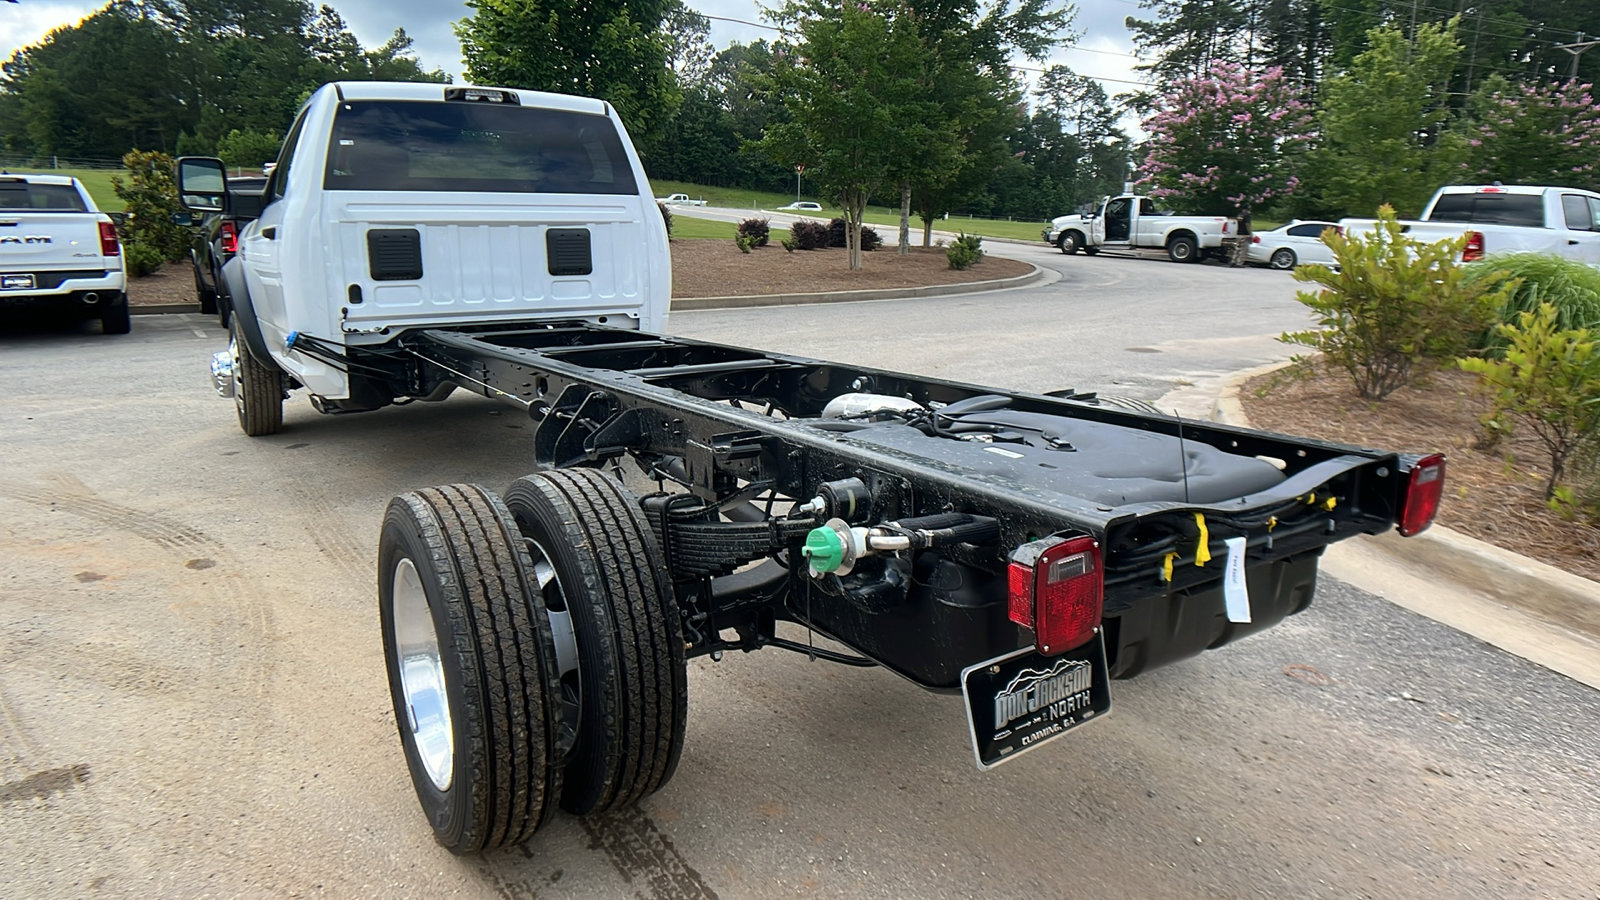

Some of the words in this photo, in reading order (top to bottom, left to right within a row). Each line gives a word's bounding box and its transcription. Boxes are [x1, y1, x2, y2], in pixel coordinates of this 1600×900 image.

[0, 236, 52, 244] AM
[995, 691, 1028, 730] DON
[1028, 664, 1092, 712] JACKSON
[1049, 690, 1091, 720] NORTH
[1063, 716, 1076, 728] GA
